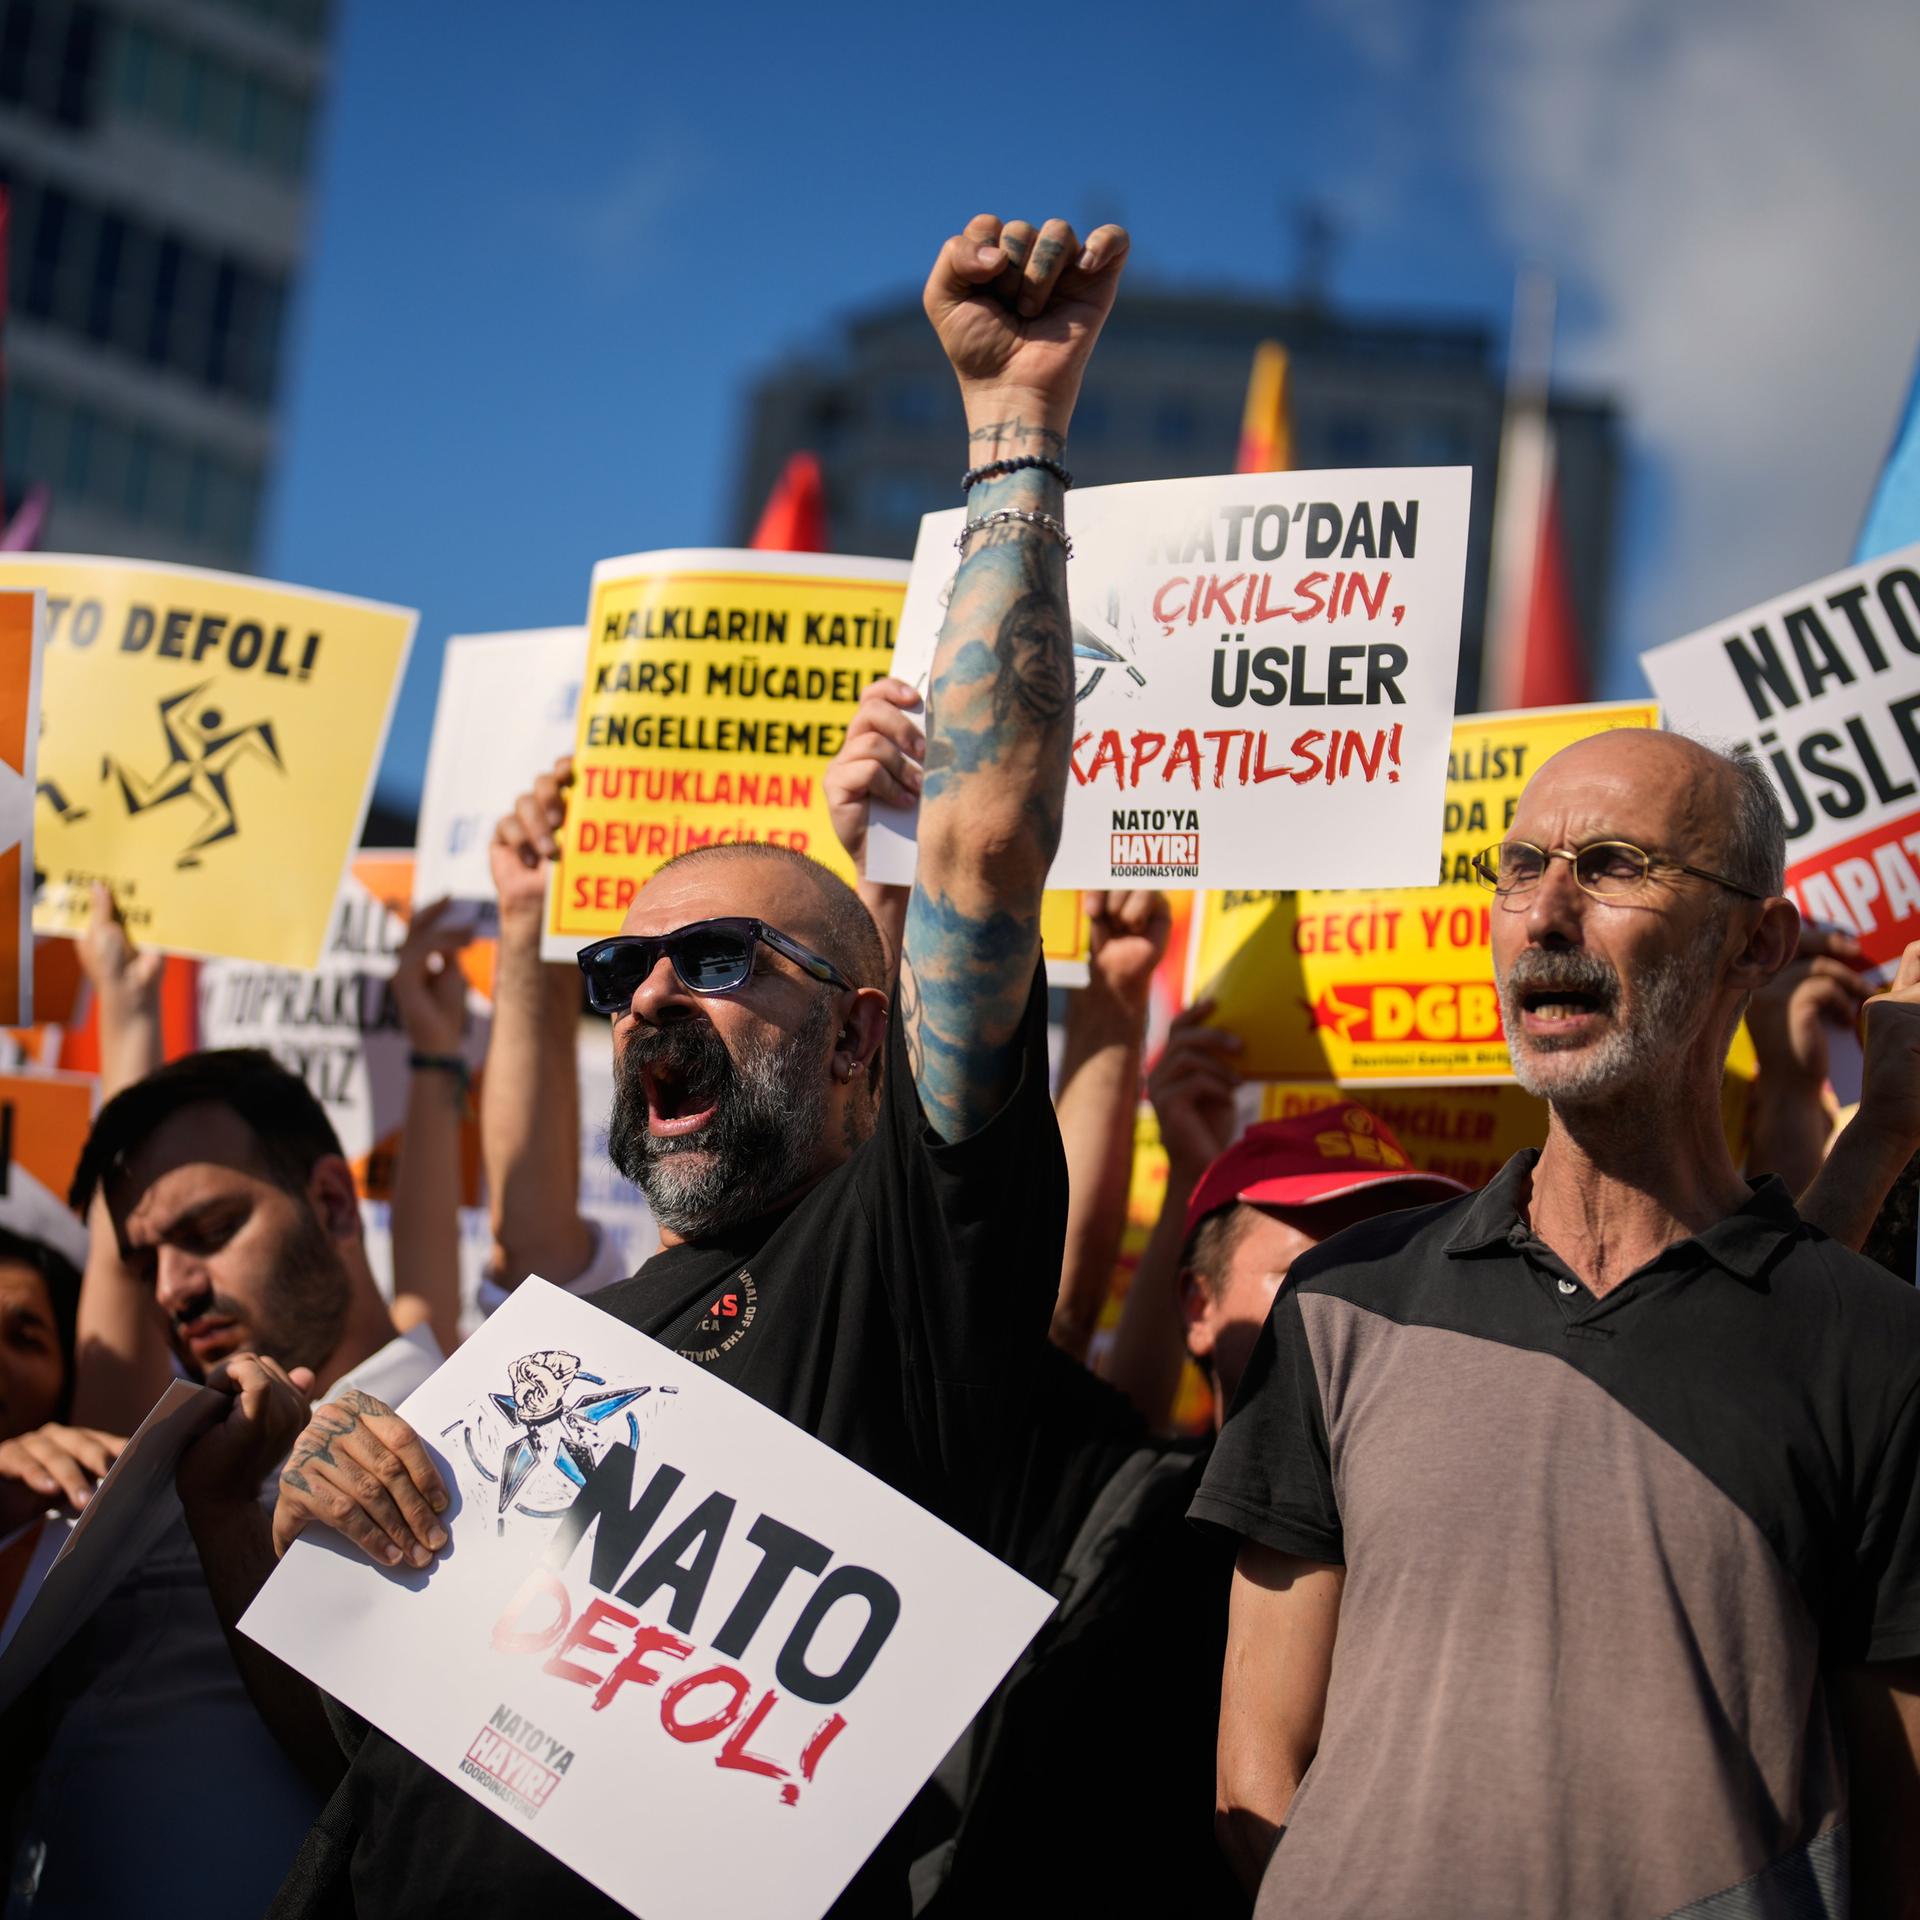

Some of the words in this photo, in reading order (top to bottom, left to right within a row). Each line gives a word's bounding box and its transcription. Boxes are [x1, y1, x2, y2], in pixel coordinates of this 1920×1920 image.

[603, 607, 788, 644] HALKLARIN
[1152, 571, 1405, 636] ÇIKILSIN,
[119, 601, 322, 682] DEFOL!
[594, 661, 691, 696] KARŞI
[706, 656, 887, 702] MÜCADEL
[1210, 633, 1408, 708] ÜSLER
[587, 716, 847, 756] ENGELLENEME
[1070, 723, 1403, 792] KAPATILSIN!
[584, 767, 813, 808] TUTUKLANAN
[1112, 810, 1199, 830] NATO'YA
[1112, 834, 1198, 864] HAYIR!
[574, 874, 646, 910] SER
[1786, 831, 1920, 938] APA
[1292, 900, 1400, 957] GEÇİT
[720, 1330, 745, 1351] THE
[741, 1306, 757, 1328] OFF
[541, 1441, 901, 1705] NATO
[491, 1569, 847, 1806] DEFOL!
[489, 1703, 576, 1776] NATO'YA
